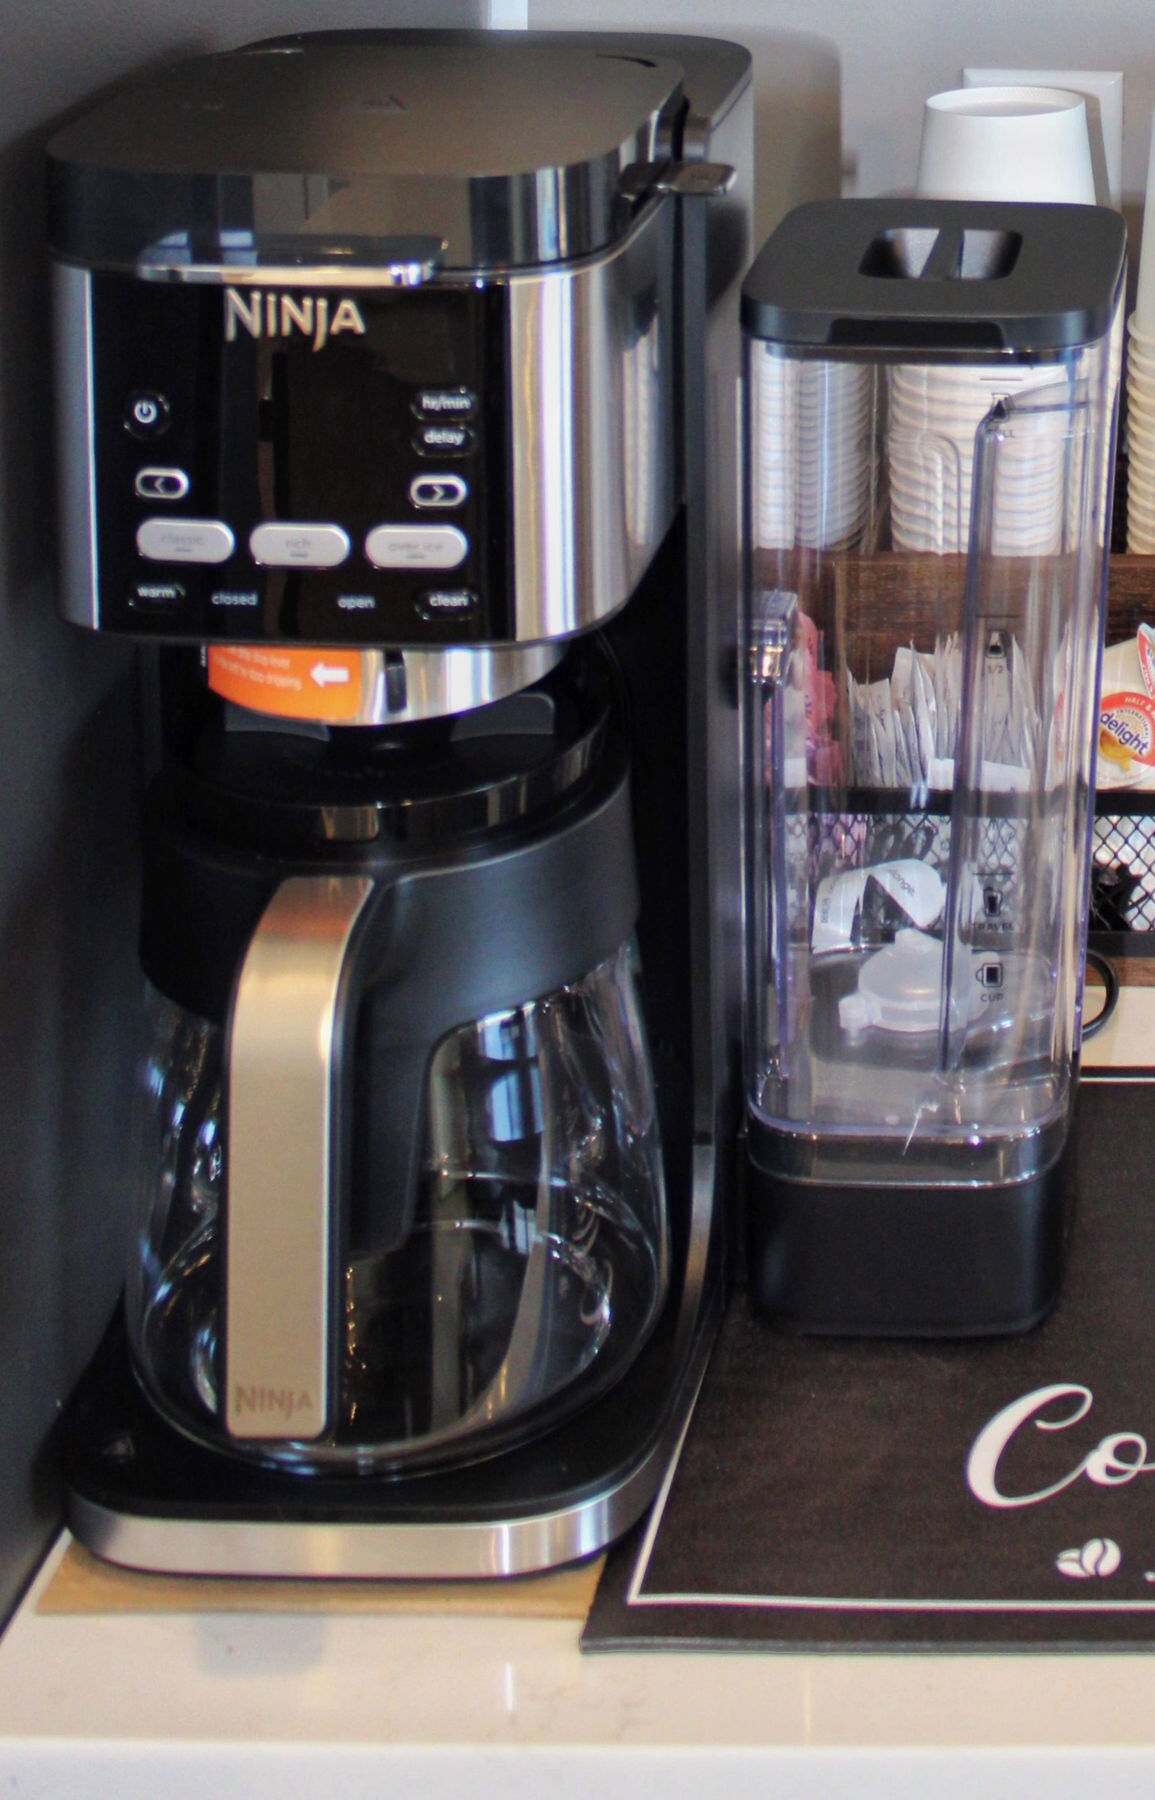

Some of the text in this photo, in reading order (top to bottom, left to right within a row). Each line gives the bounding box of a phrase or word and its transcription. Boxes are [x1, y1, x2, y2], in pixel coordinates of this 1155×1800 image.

[224, 287, 366, 352] NINJA
[422, 394, 471, 411] hr/min
[424, 429, 465, 446] delay
[137, 585, 176, 598] warm
[211, 591, 259, 606] closed
[428, 591, 469, 607] clean
[337, 595, 376, 610] open
[1100, 712, 1149, 756] delight
[235, 1383, 314, 1420] NINJA
